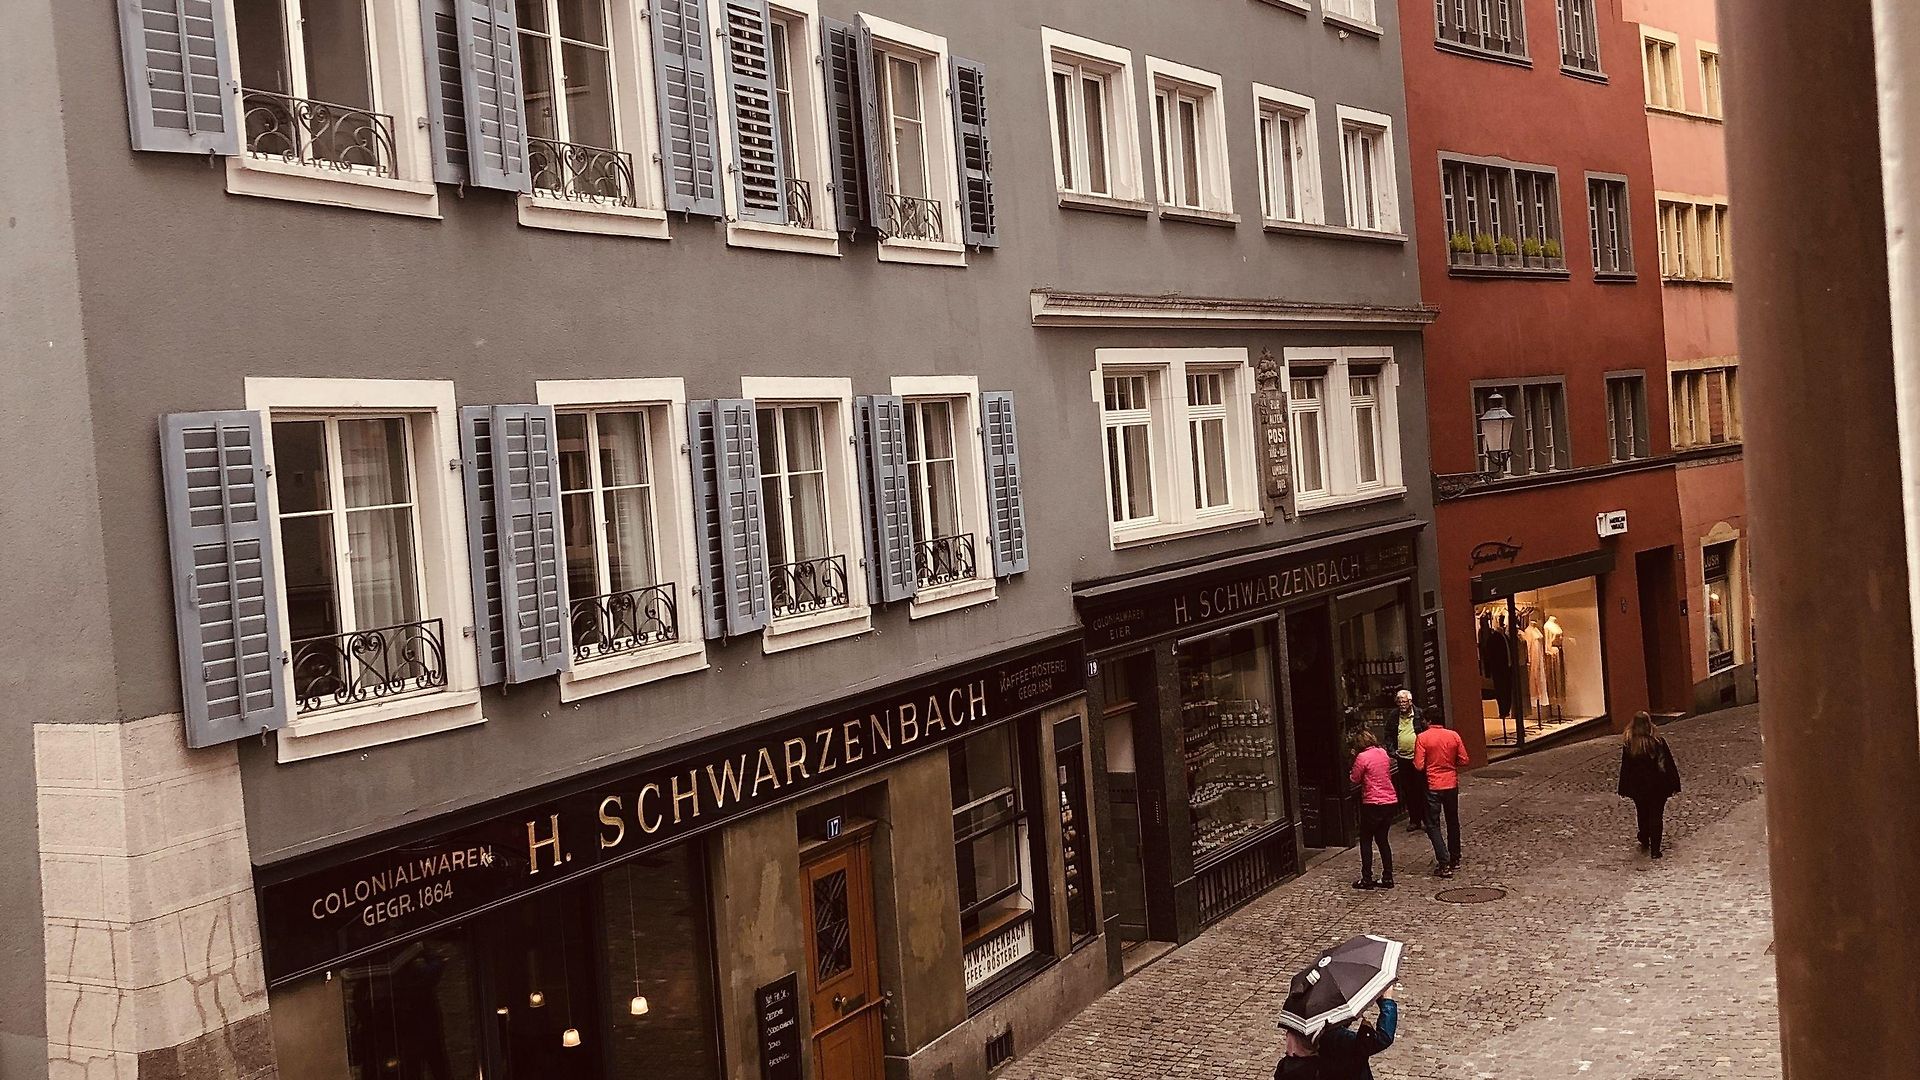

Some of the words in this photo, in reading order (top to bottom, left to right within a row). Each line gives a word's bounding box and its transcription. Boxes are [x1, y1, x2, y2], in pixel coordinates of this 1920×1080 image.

[1267, 428, 1287, 445] POST
[1174, 595, 1192, 625] H.
[1200, 554, 1361, 618] SCHWARZENBACH
[1110, 625, 1131, 640] EIER
[1089, 661, 1098, 675] 19
[526, 814, 572, 875] H.
[599, 679, 988, 850] SCHWARZENBACH
[829, 819, 841, 837] 17
[311, 844, 495, 919] COLONIALWAREN
[362, 892, 416, 927] GEGR.
[418, 879, 454, 910] 1864
